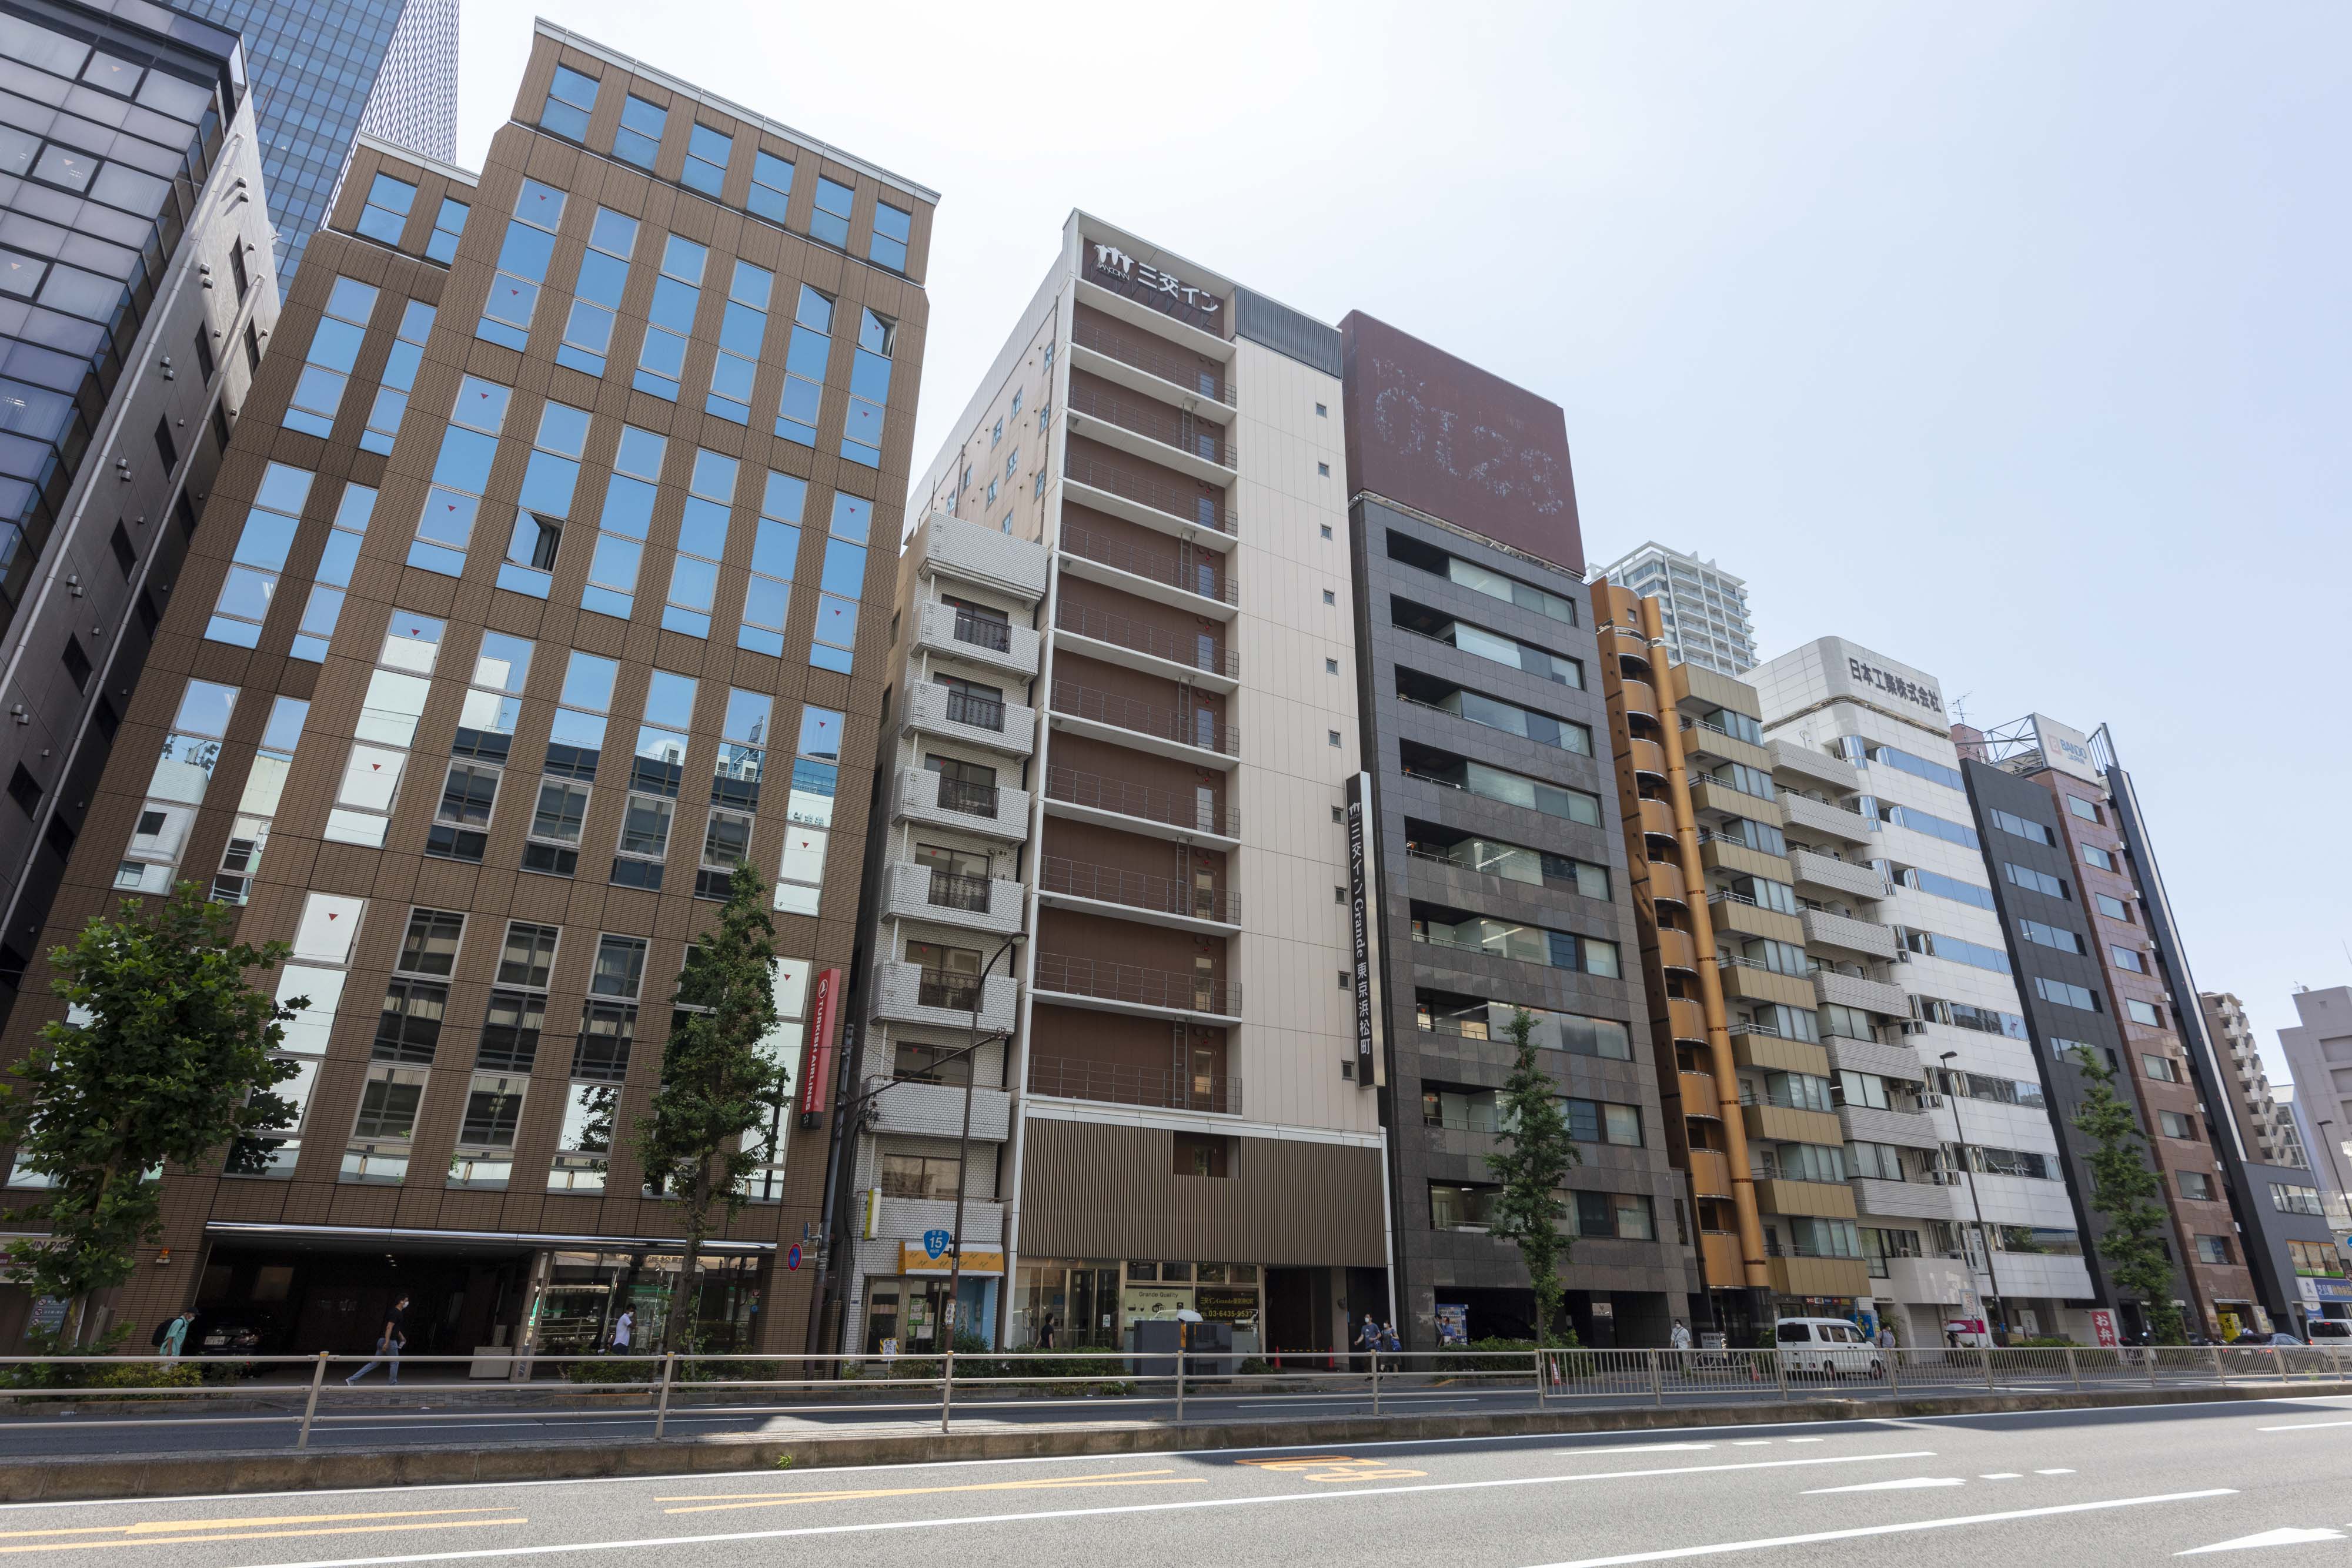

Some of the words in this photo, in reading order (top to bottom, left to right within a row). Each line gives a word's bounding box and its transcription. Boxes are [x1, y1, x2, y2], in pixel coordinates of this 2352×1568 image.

[1137, 262, 1219, 312] 三交イン
[813, 999, 823, 1052] TURKISH
[806, 1054, 817, 1110] AIRLINES
[930, 1236, 943, 1249] 15
[2096, 1315, 2116, 1347] お弁
